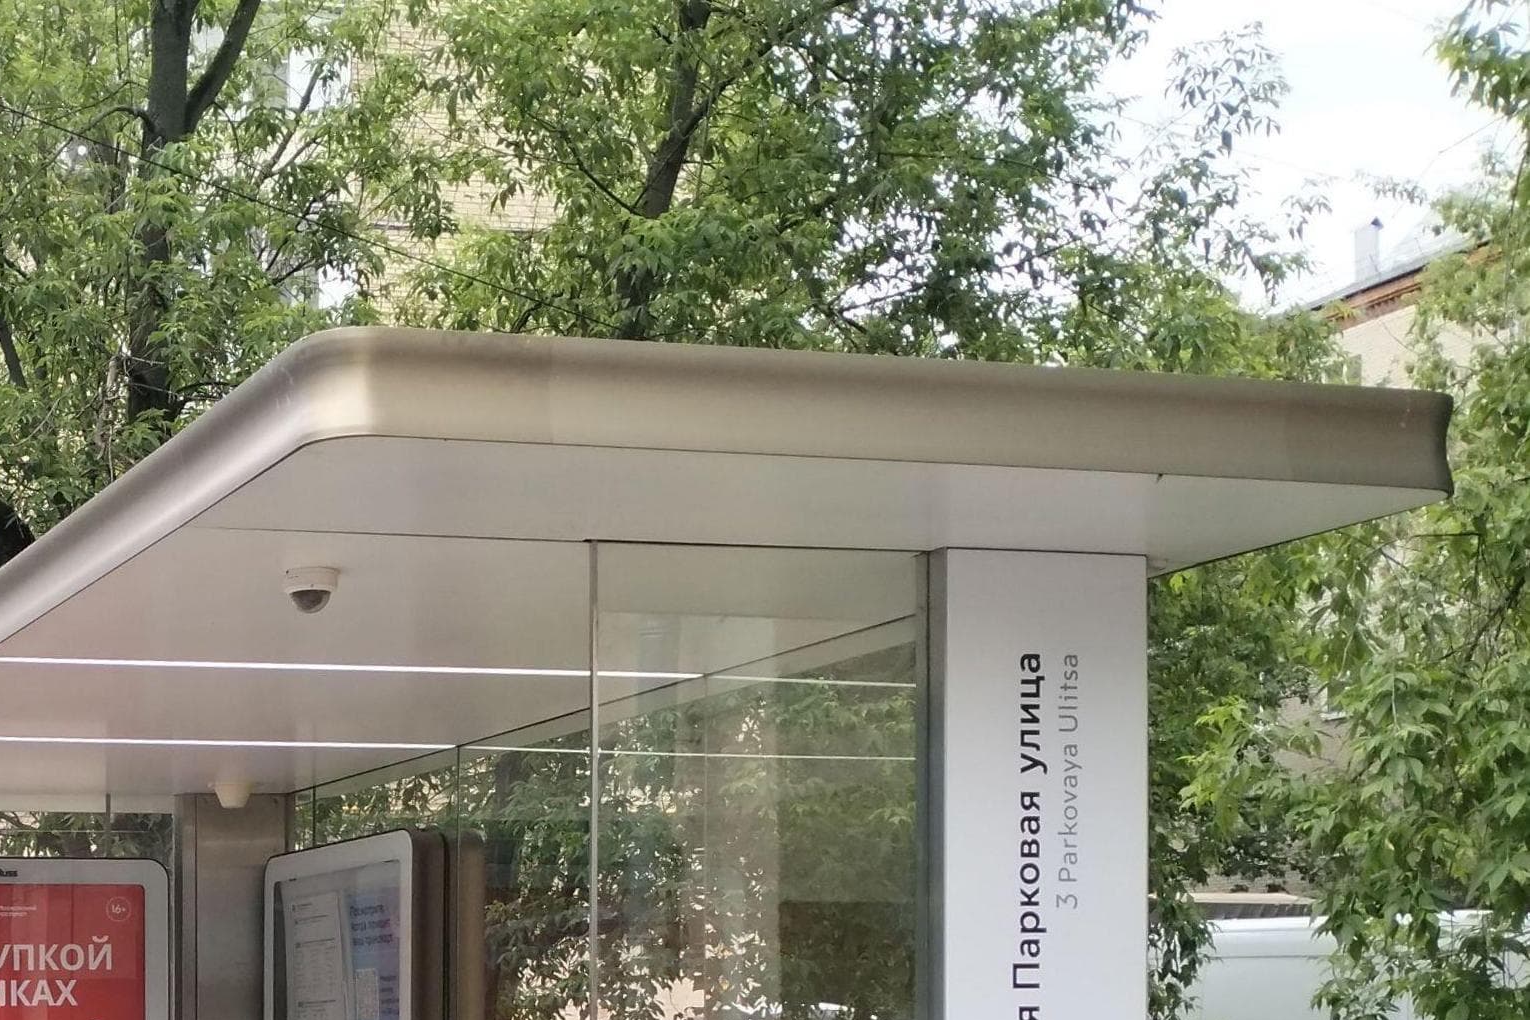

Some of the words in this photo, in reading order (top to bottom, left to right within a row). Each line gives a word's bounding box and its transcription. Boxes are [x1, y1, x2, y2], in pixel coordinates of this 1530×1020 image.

[1019, 653, 1047, 774] улица
[1058, 653, 1079, 733] Ulitsa
[1058, 743, 1083, 883] Parkovaya
[1012, 791, 1047, 990] Парковая
[1056, 894, 1078, 910] 3
